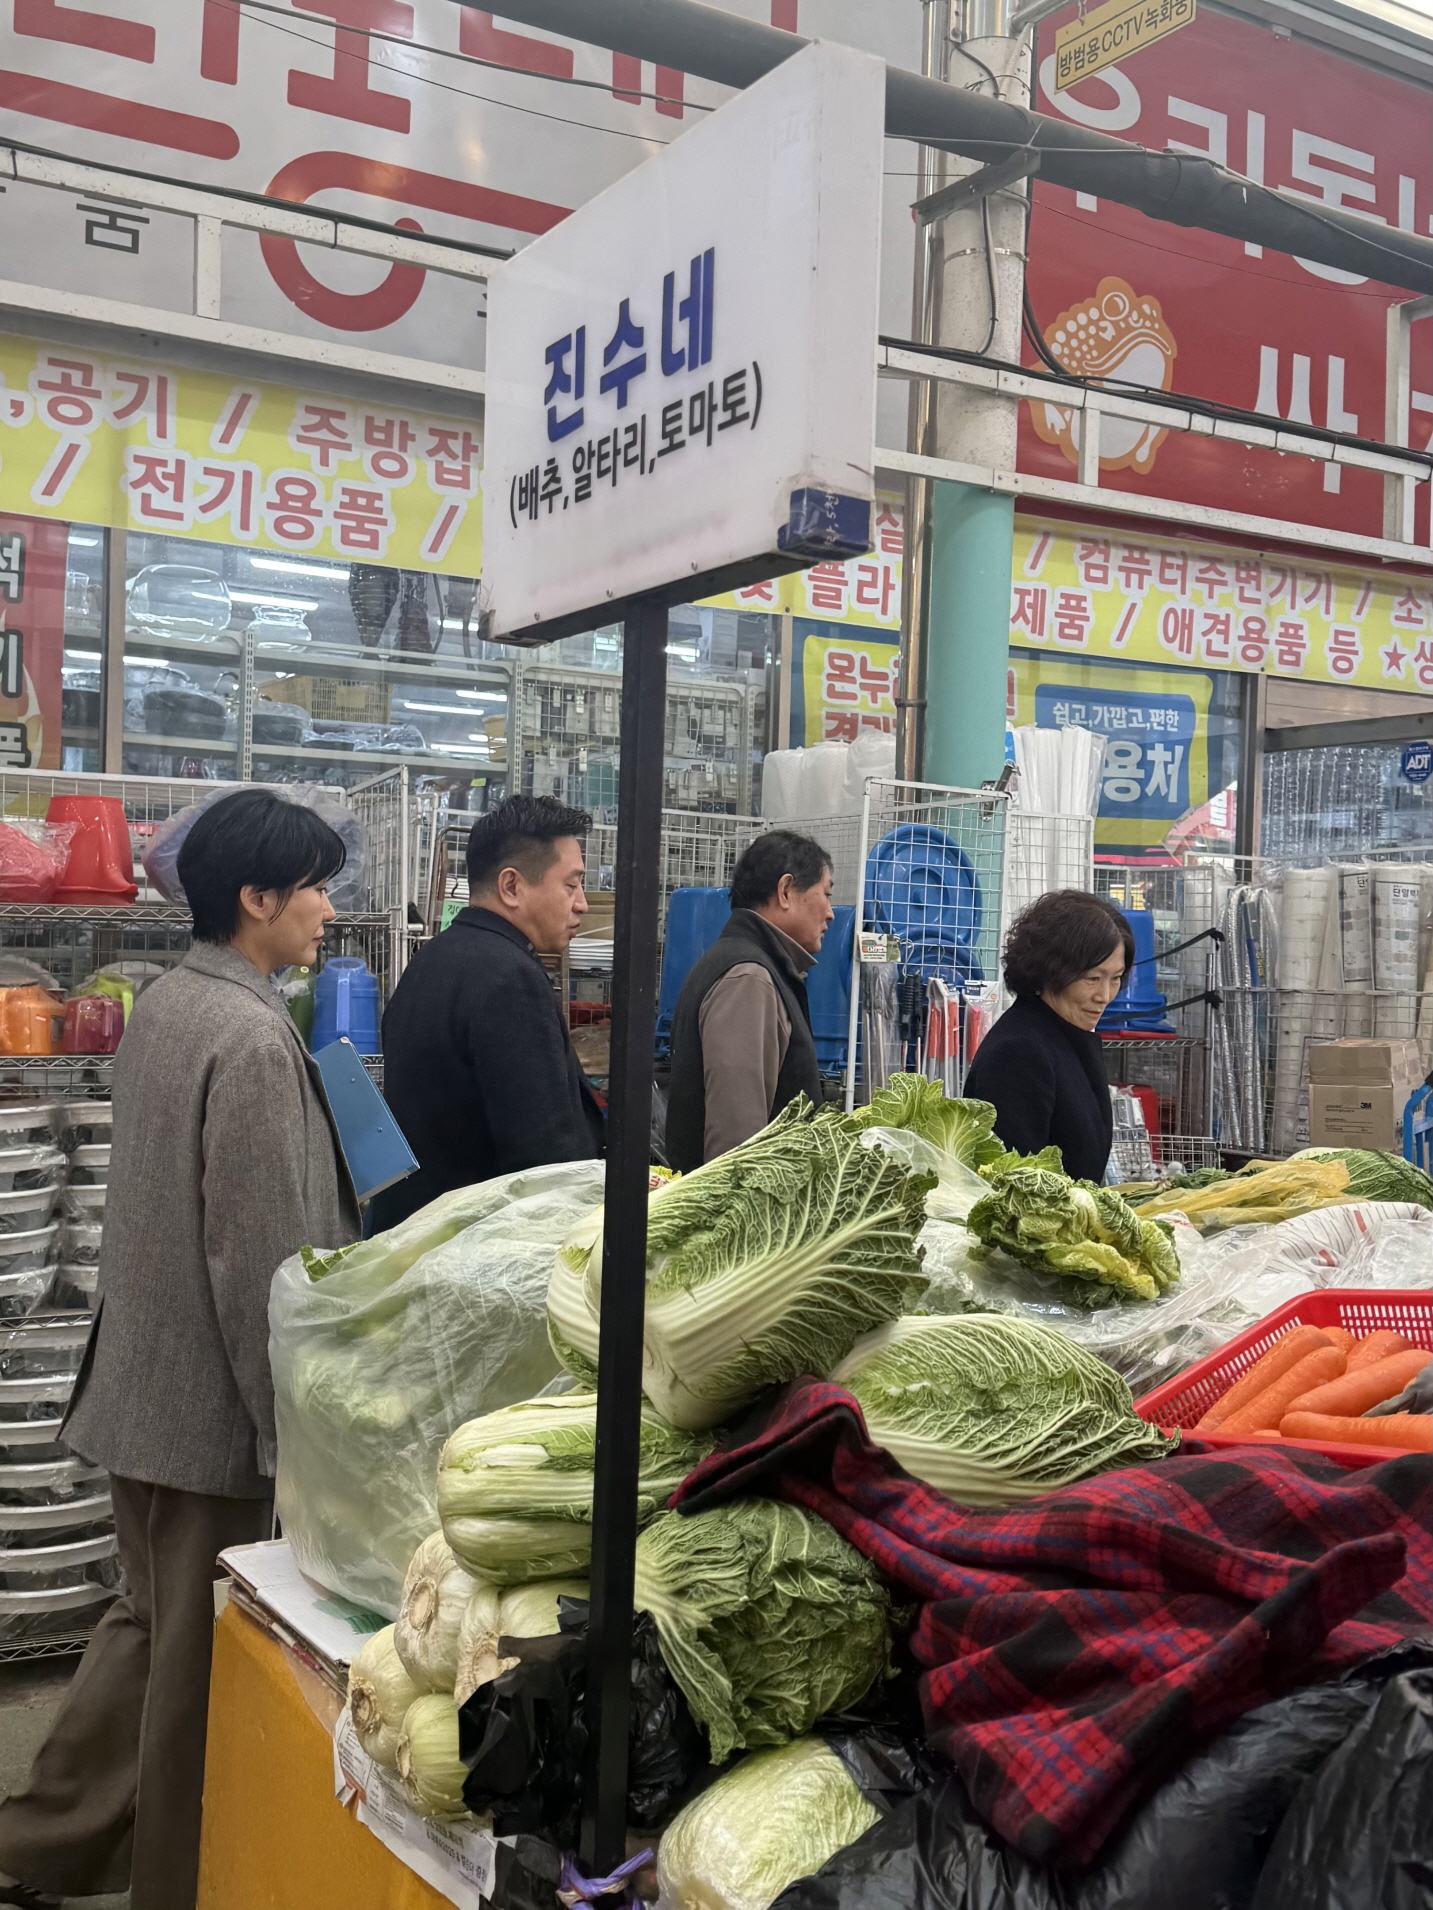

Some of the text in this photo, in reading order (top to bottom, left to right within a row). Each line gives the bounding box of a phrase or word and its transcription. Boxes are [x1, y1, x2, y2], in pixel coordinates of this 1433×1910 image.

[544, 247, 714, 442] 진수네
[509, 362, 762, 528] (배추,알타리,토마토)
[129, 453, 389, 549] 전기용품
[1079, 537, 1331, 615] 컴퓨터주변기기
[1011, 587, 1090, 641] 제품
[1163, 607, 1306, 667] 애견용품
[1329, 629, 1359, 674] 등
[826, 652, 900, 704] 온누
[1053, 702, 1179, 732] 쉽고,가깝고,편한
[1406, 754, 1431, 770] ADT
